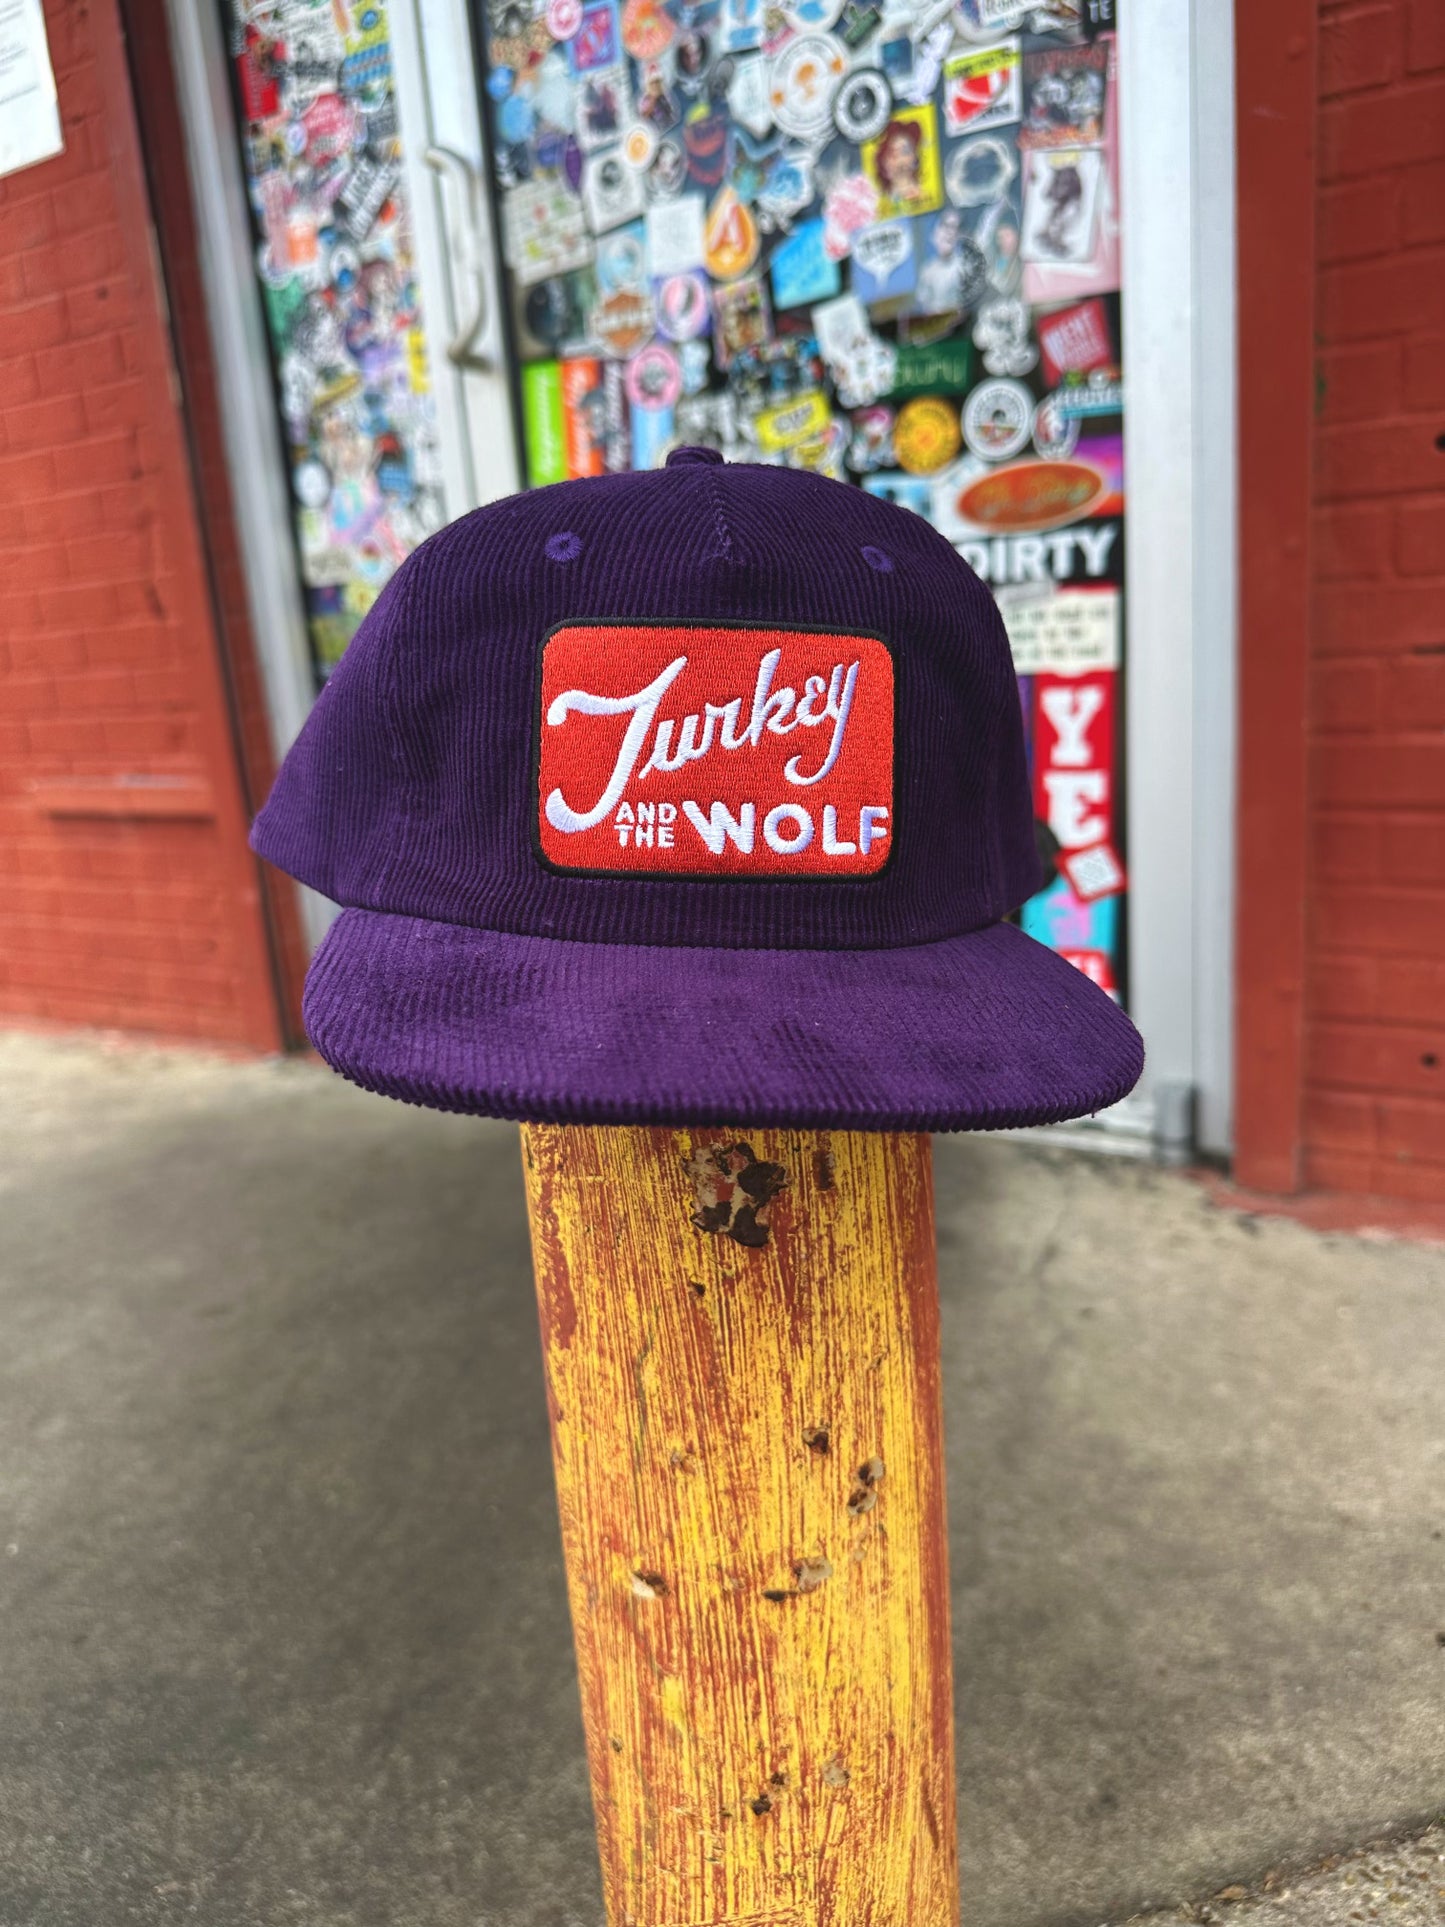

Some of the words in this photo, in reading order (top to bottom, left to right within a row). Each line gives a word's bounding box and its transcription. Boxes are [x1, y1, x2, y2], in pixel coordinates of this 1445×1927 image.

[955, 522, 1117, 583] DIRTY
[545, 648, 860, 834] Turkey
[613, 824, 676, 848] THE
[614, 801, 678, 824] AND
[682, 800, 889, 856] WOLF
